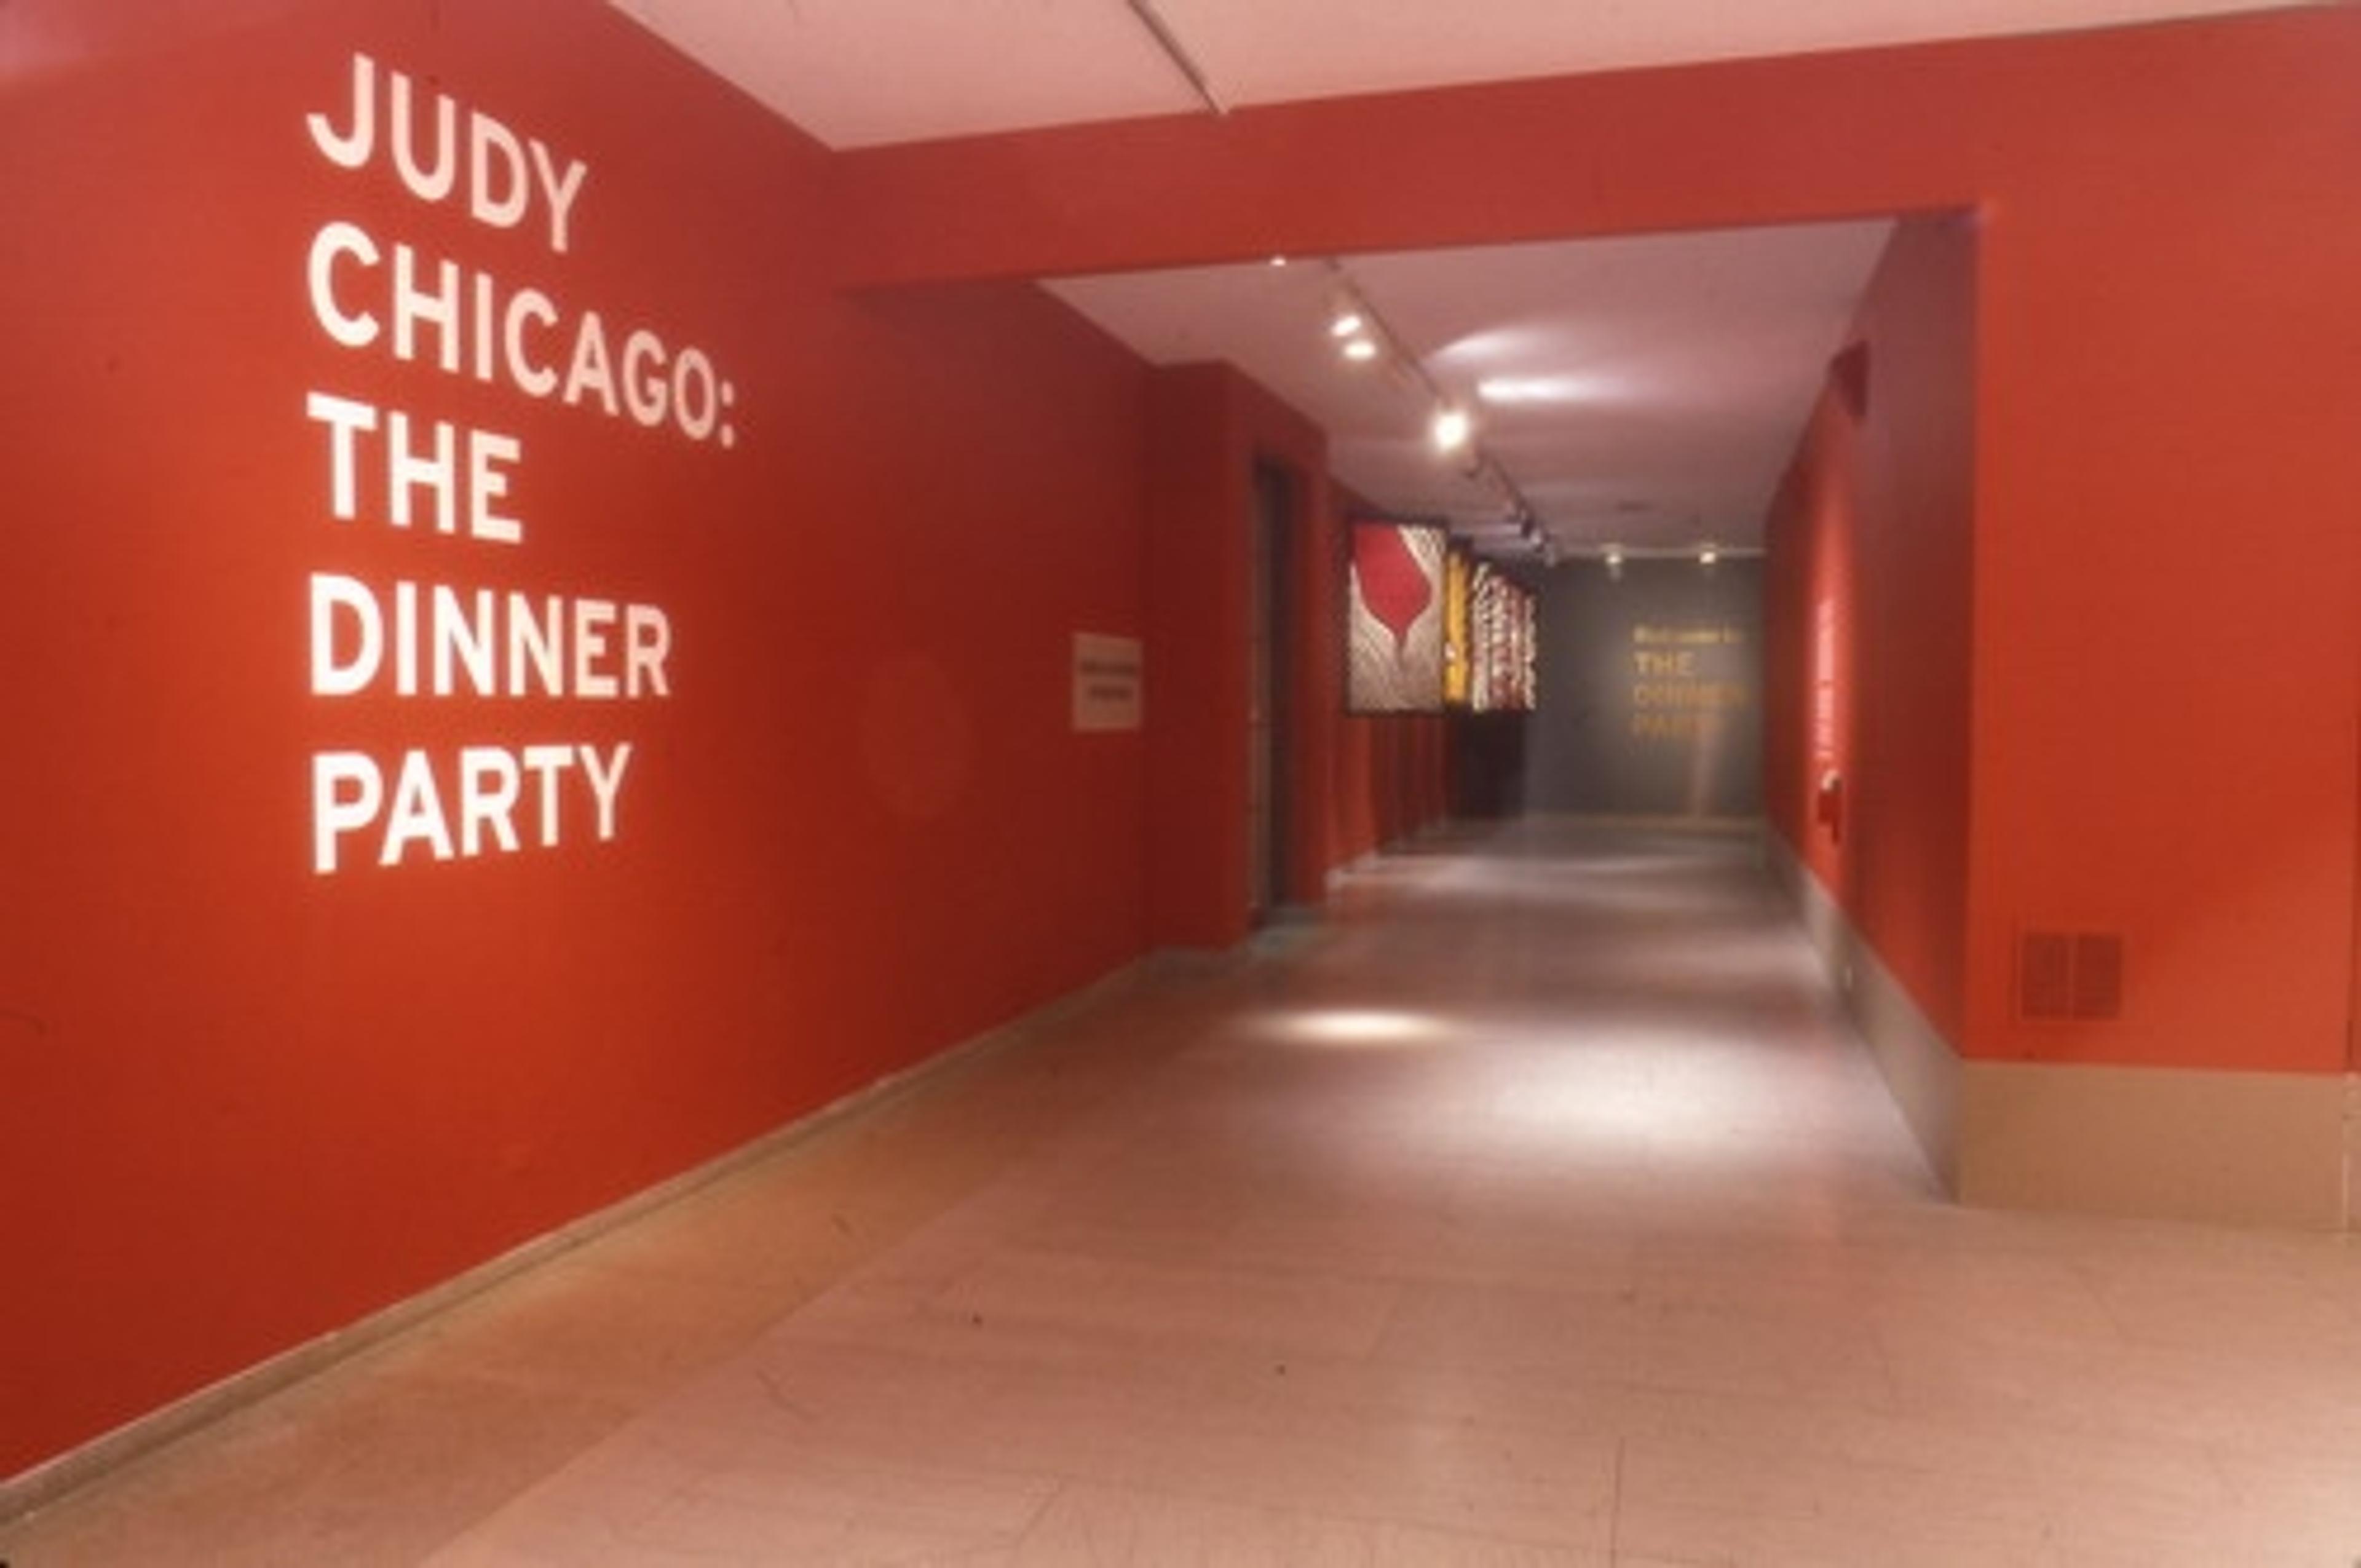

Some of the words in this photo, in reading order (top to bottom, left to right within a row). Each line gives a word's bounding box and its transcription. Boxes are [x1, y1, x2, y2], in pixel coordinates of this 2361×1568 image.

[306, 53, 587, 252] JUDY
[306, 221, 733, 446] CHICAGO:
[305, 390, 523, 544] THE
[307, 571, 670, 699] DINNER
[310, 743, 631, 875] PARTY
